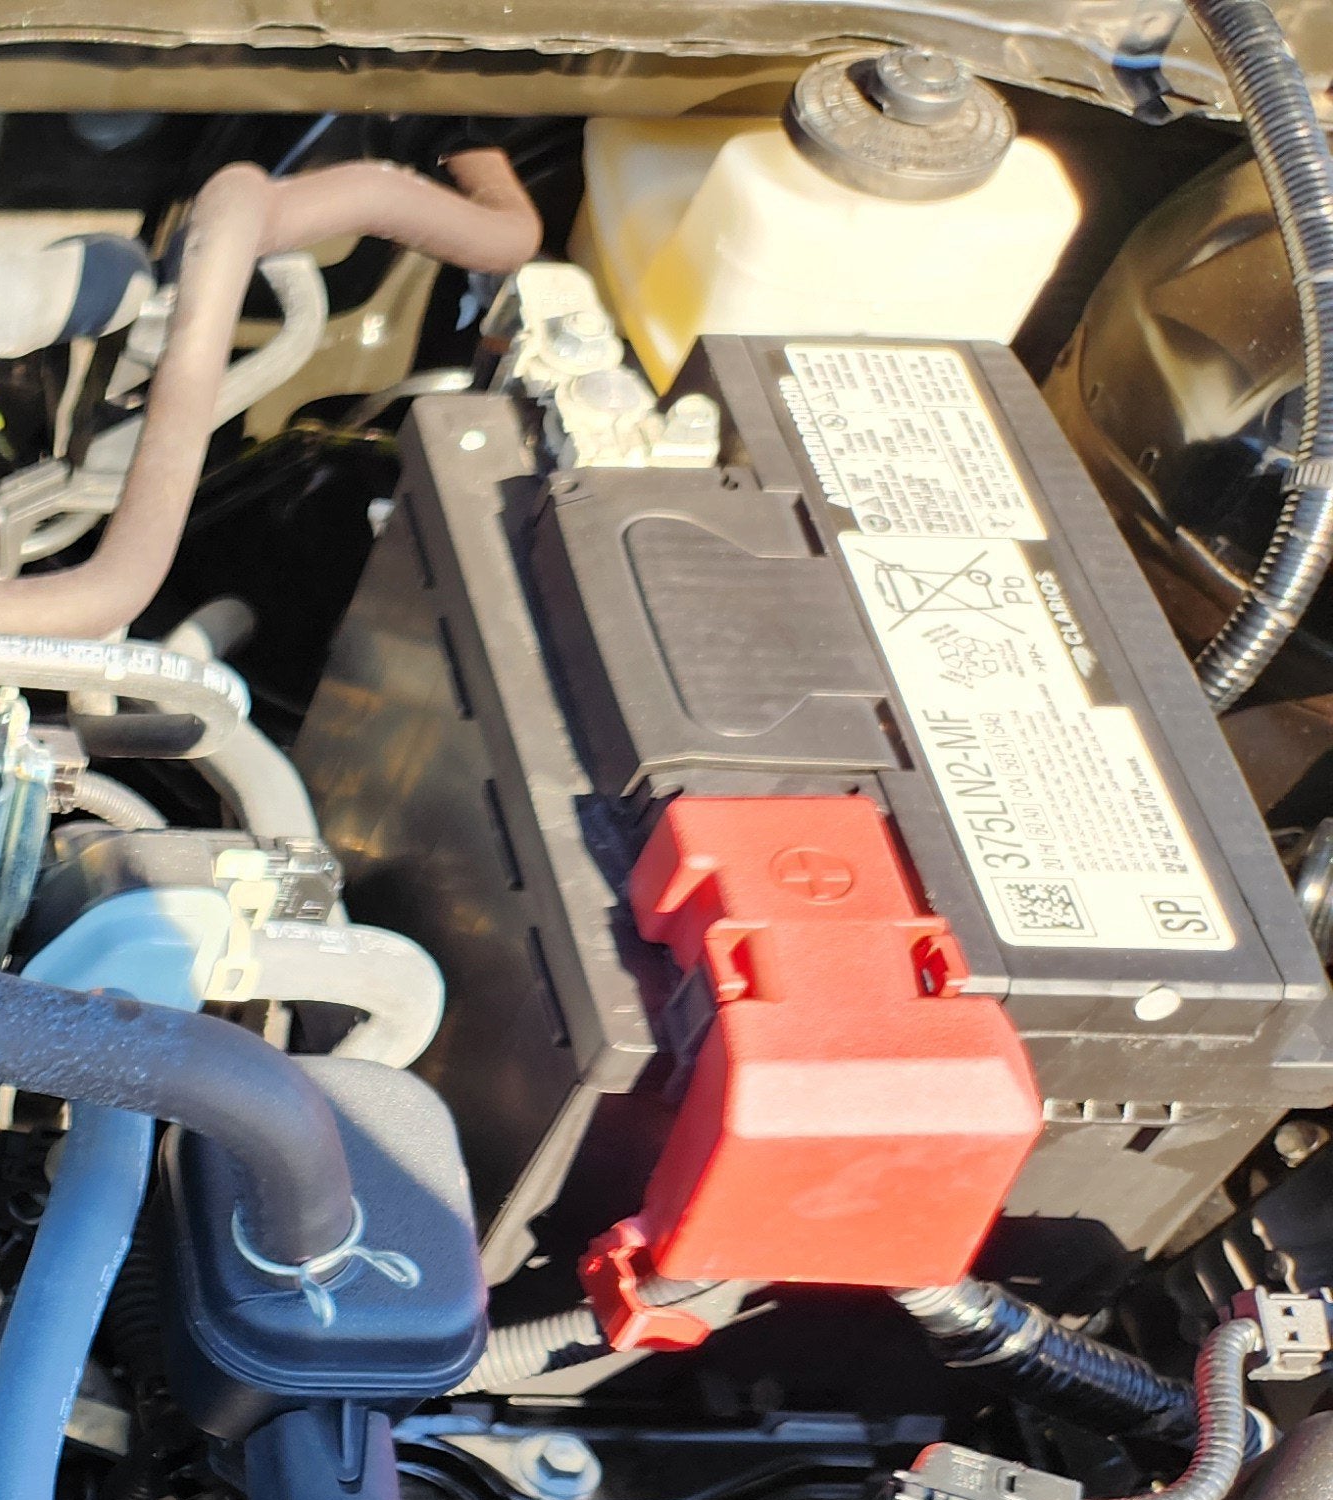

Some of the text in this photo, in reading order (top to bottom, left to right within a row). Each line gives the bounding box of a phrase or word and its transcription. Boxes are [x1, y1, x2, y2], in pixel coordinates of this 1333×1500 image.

[1002, 576, 1033, 604] Pb
[1035, 569, 1084, 646] CLARIOS
[931, 710, 1031, 869] 375LN2-MF
[1152, 900, 1208, 932] SP
